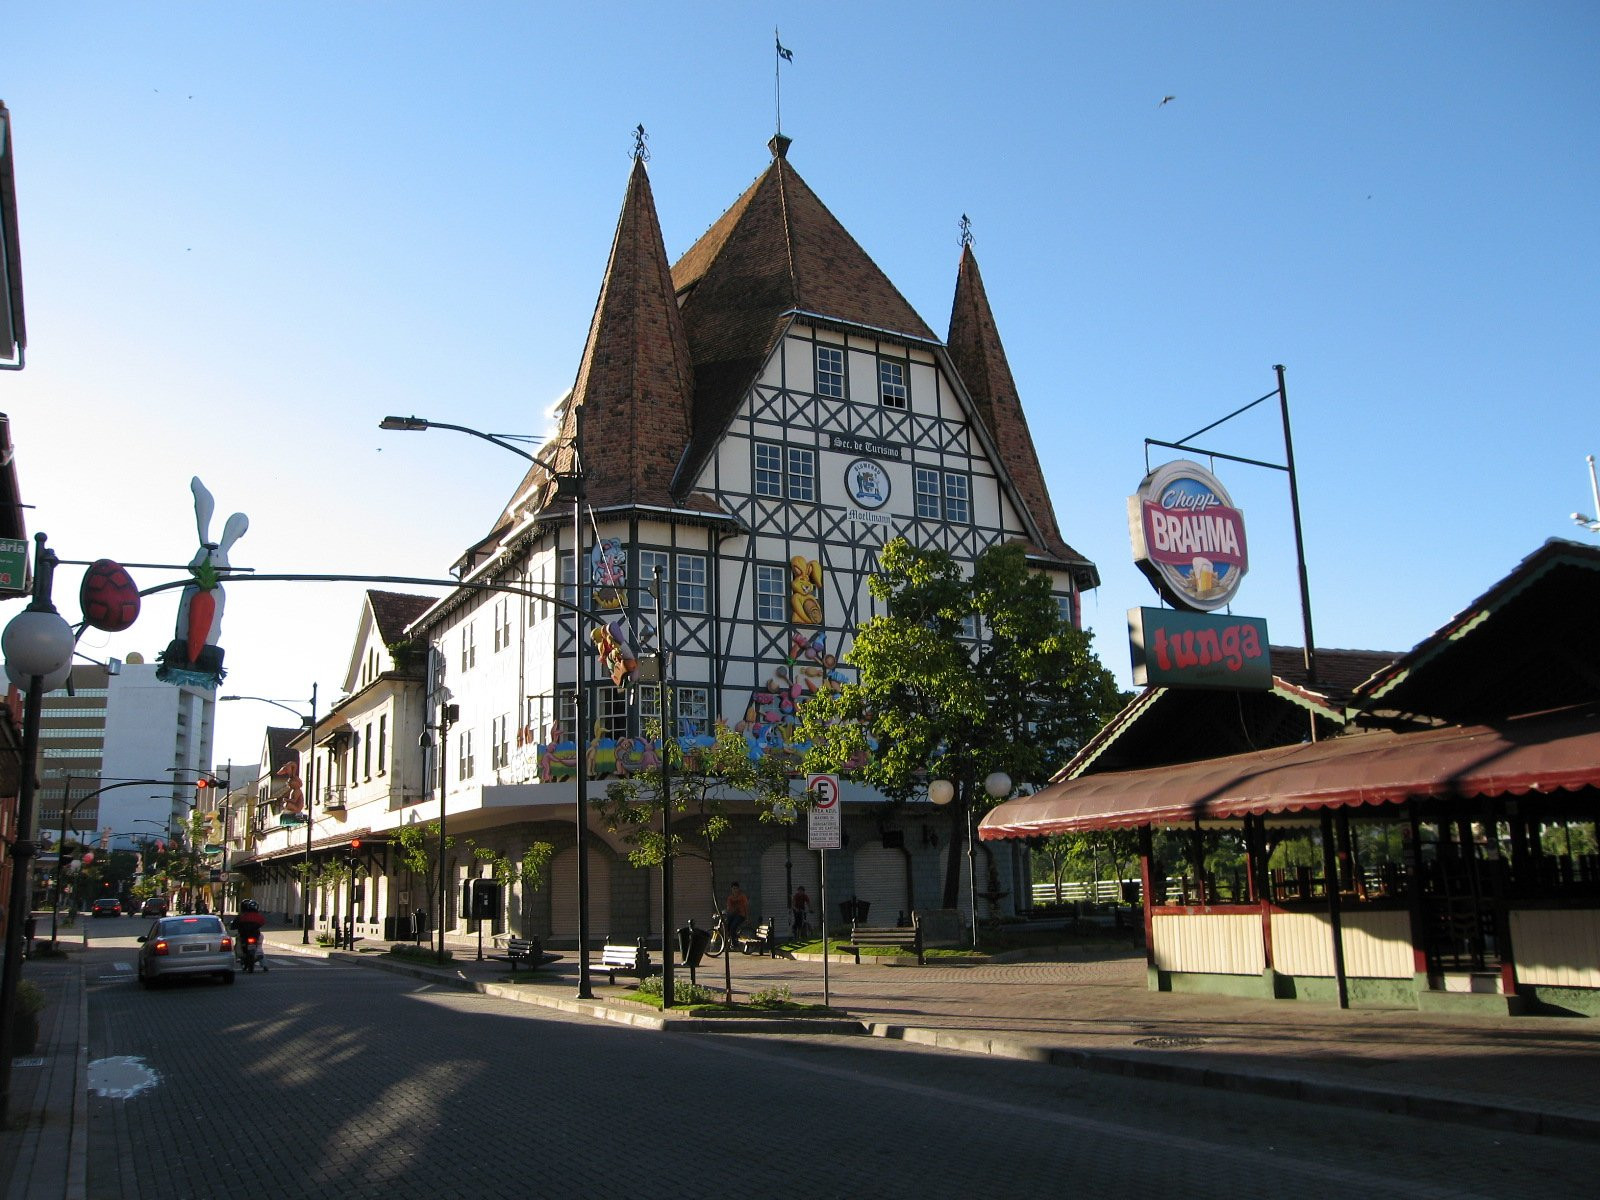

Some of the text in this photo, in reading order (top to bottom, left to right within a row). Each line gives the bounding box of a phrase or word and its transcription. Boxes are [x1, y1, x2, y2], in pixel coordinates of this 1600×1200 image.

[833, 436, 899, 457] Sec. de Turismo
[1161, 489, 1219, 512] Chopp
[848, 509, 891, 524] Moellmann
[1151, 509, 1241, 557] BRAHMA
[1153, 624, 1262, 672] tunga
[818, 783, 829, 801] E
